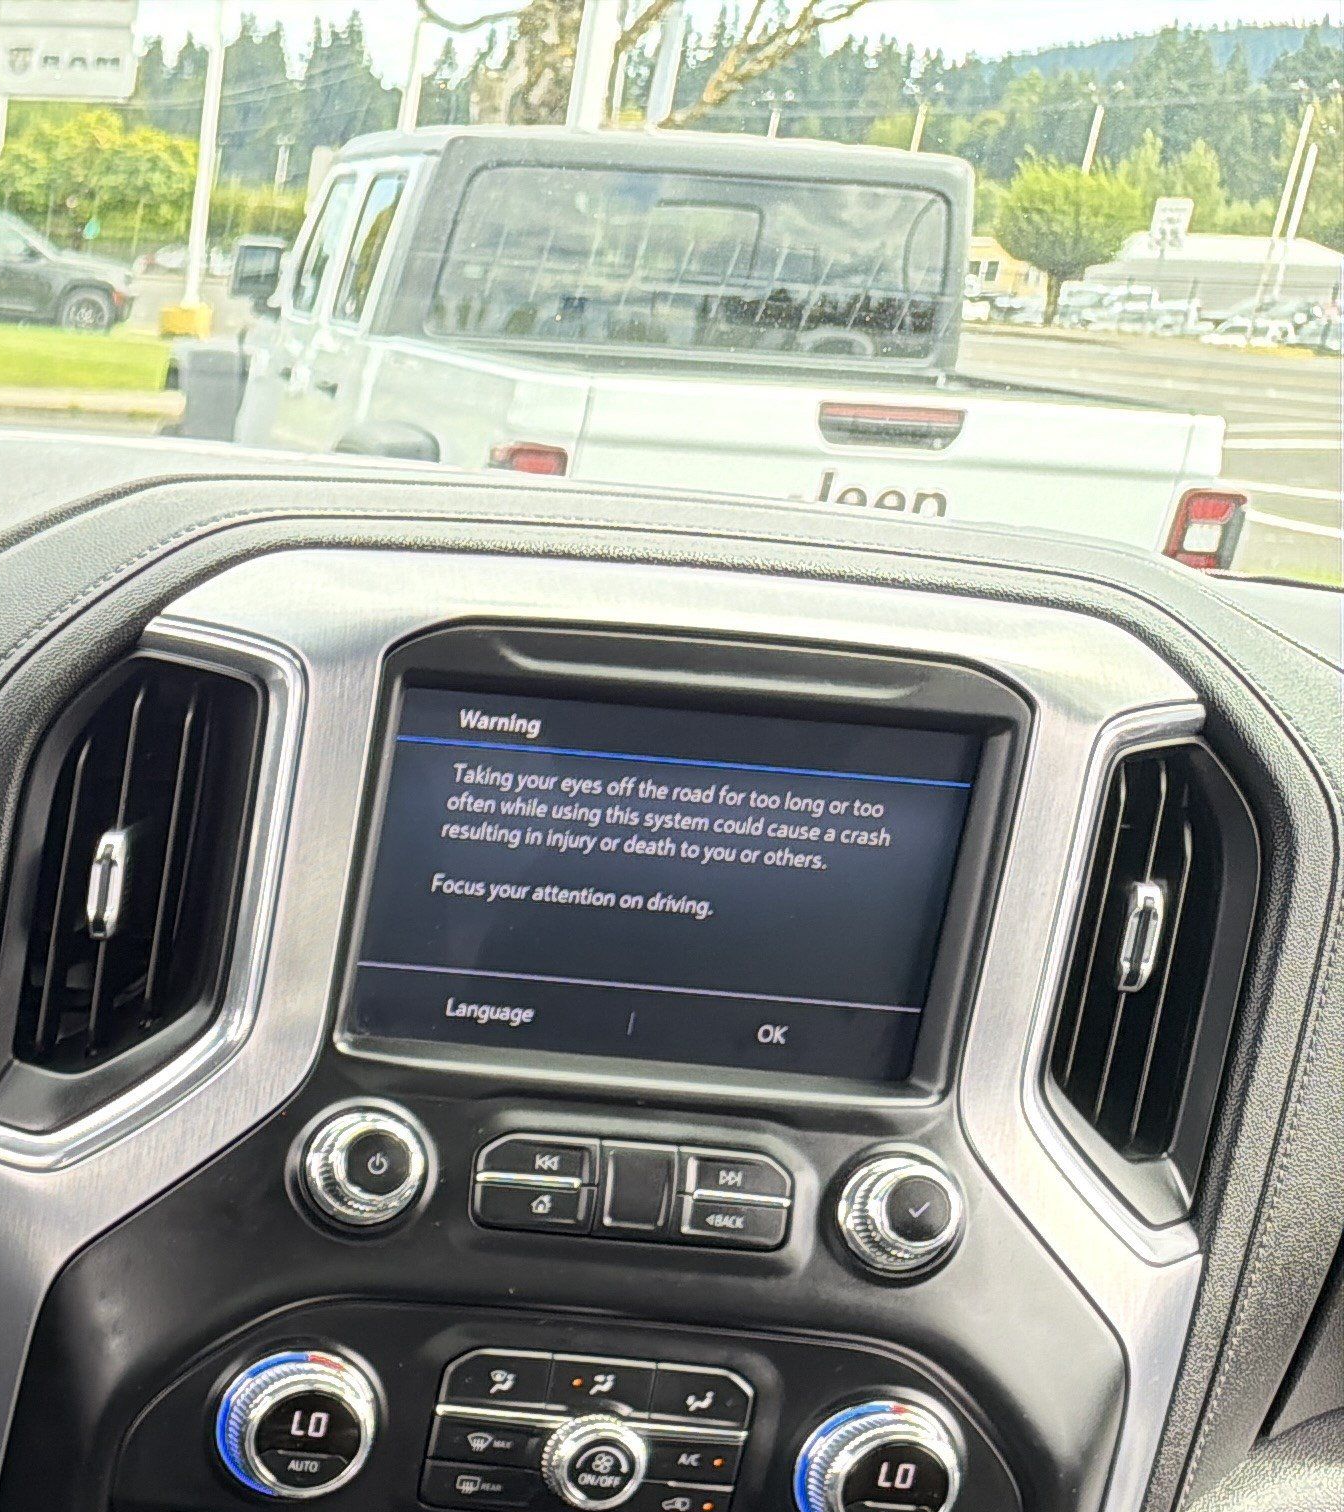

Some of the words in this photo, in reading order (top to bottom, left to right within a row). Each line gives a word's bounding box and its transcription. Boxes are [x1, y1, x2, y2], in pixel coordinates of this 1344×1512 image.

[460, 708, 542, 739] Warning
[453, 762, 514, 792] Taking
[514, 773, 558, 793] your
[561, 777, 602, 797] eyes
[607, 776, 637, 797] off
[638, 778, 669, 800] the
[672, 784, 716, 804] road
[718, 784, 746, 806] for
[749, 791, 781, 809] too
[784, 791, 825, 818] long
[828, 800, 850, 814] or
[853, 799, 884, 818] too
[447, 791, 496, 814] often
[500, 796, 548, 818] while
[551, 805, 601, 828] using
[605, 804, 640, 826] this
[643, 812, 709, 832] system
[713, 816, 765, 836] could
[767, 822, 821, 841] cause
[824, 828, 836, 842] a
[840, 827, 891, 847] crash
[441, 821, 522, 849] resulting
[524, 827, 542, 846] in
[546, 829, 597, 855] injury
[600, 835, 620, 852] or
[623, 834, 676, 857] death
[680, 840, 700, 859] to
[701, 845, 737, 865] you
[739, 850, 760, 864] or
[763, 848, 828, 870] others.
[431, 872, 486, 898] Focus
[486, 882, 531, 902] your
[531, 884, 616, 907] attention
[619, 893, 643, 910] on
[647, 891, 714, 920] driving.
[446, 997, 535, 1027] Language
[757, 1023, 788, 1045] OK
[714, 1213, 744, 1229] BACK
[290, 1410, 329, 1438] LO
[287, 1459, 320, 1474] AUTO
[677, 1453, 701, 1467] A/C
[577, 1472, 623, 1488] ON/OFF
[877, 1461, 916, 1489] LO
